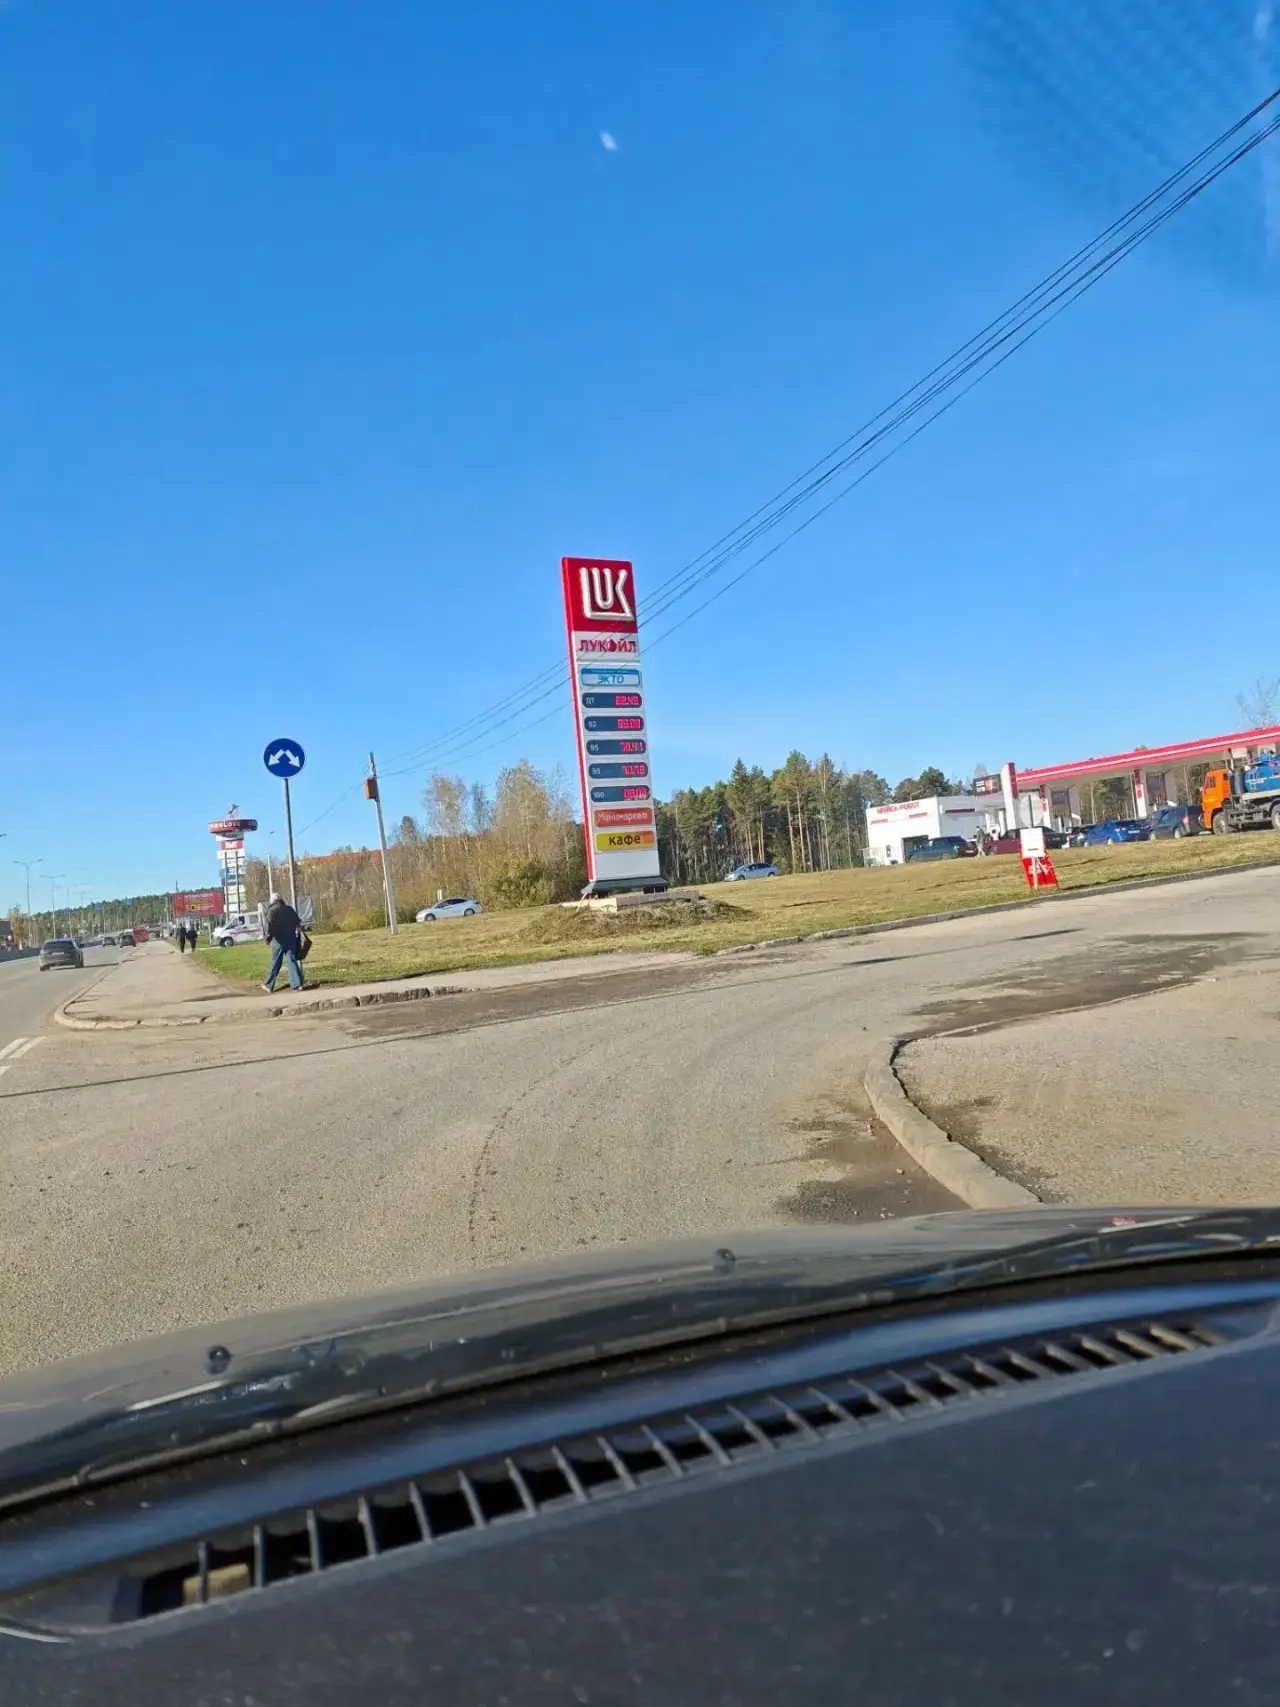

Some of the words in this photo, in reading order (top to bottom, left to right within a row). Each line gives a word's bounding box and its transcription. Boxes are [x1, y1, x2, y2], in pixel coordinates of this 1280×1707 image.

[578, 638, 637, 653] ЛУКОЙЛ
[597, 674, 625, 684] ЭКТО
[585, 696, 596, 705] ДТ
[608, 833, 641, 846] кафе
